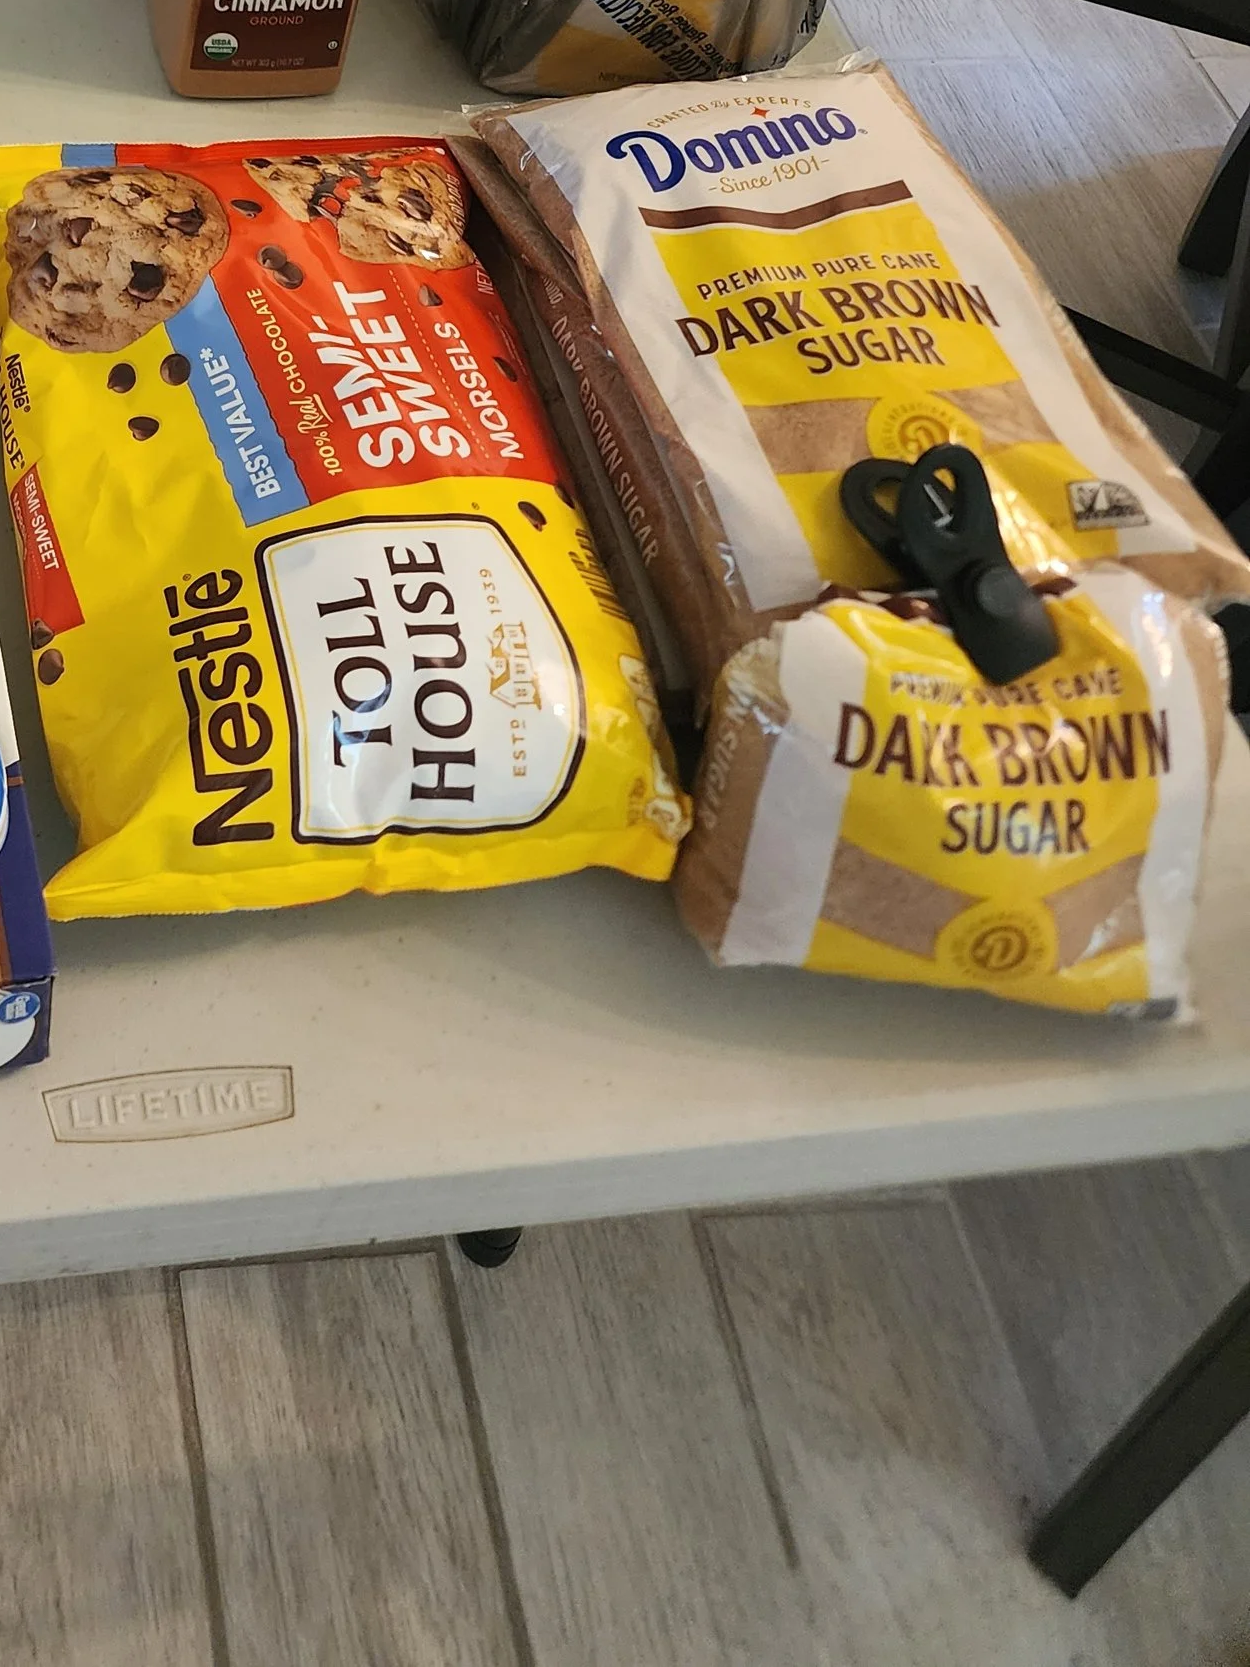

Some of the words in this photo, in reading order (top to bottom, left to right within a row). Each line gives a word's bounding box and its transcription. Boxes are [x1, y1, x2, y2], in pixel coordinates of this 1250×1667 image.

[211, 38, 232, 46] USDA
[249, 15, 304, 26] GROUND
[646, 103, 708, 128] CRAFTED
[733, 95, 812, 109] EXPERTS
[606, 107, 857, 193] Domino
[696, 264, 806, 300] PREMIUM
[812, 255, 873, 278] PURE
[882, 252, 941, 270] CANE
[246, 287, 306, 394] CHOCOLATE
[674, 290, 825, 358] DARK
[818, 278, 1002, 329] BROWN
[333, 280, 472, 460] SWEET
[796, 326, 947, 375] SUGAR
[297, 394, 333, 434] Real
[308, 314, 416, 469] SEMI-
[433, 321, 524, 460] MORSELS
[237, 444, 281, 499] BEST
[314, 430, 343, 476] 100%
[578, 377, 625, 477] BROWN
[614, 469, 660, 570] SUGAR
[23, 472, 60, 571] SEMI-SWEET
[479, 567, 503, 615] 1939
[316, 577, 393, 769] TOLL
[384, 540, 476, 804] HOUSE
[512, 720, 528, 778] ESTD
[982, 708, 1171, 787] BROWN
[939, 798, 1090, 855] SUGAR
[69, 1080, 277, 1131] LIFETIME
